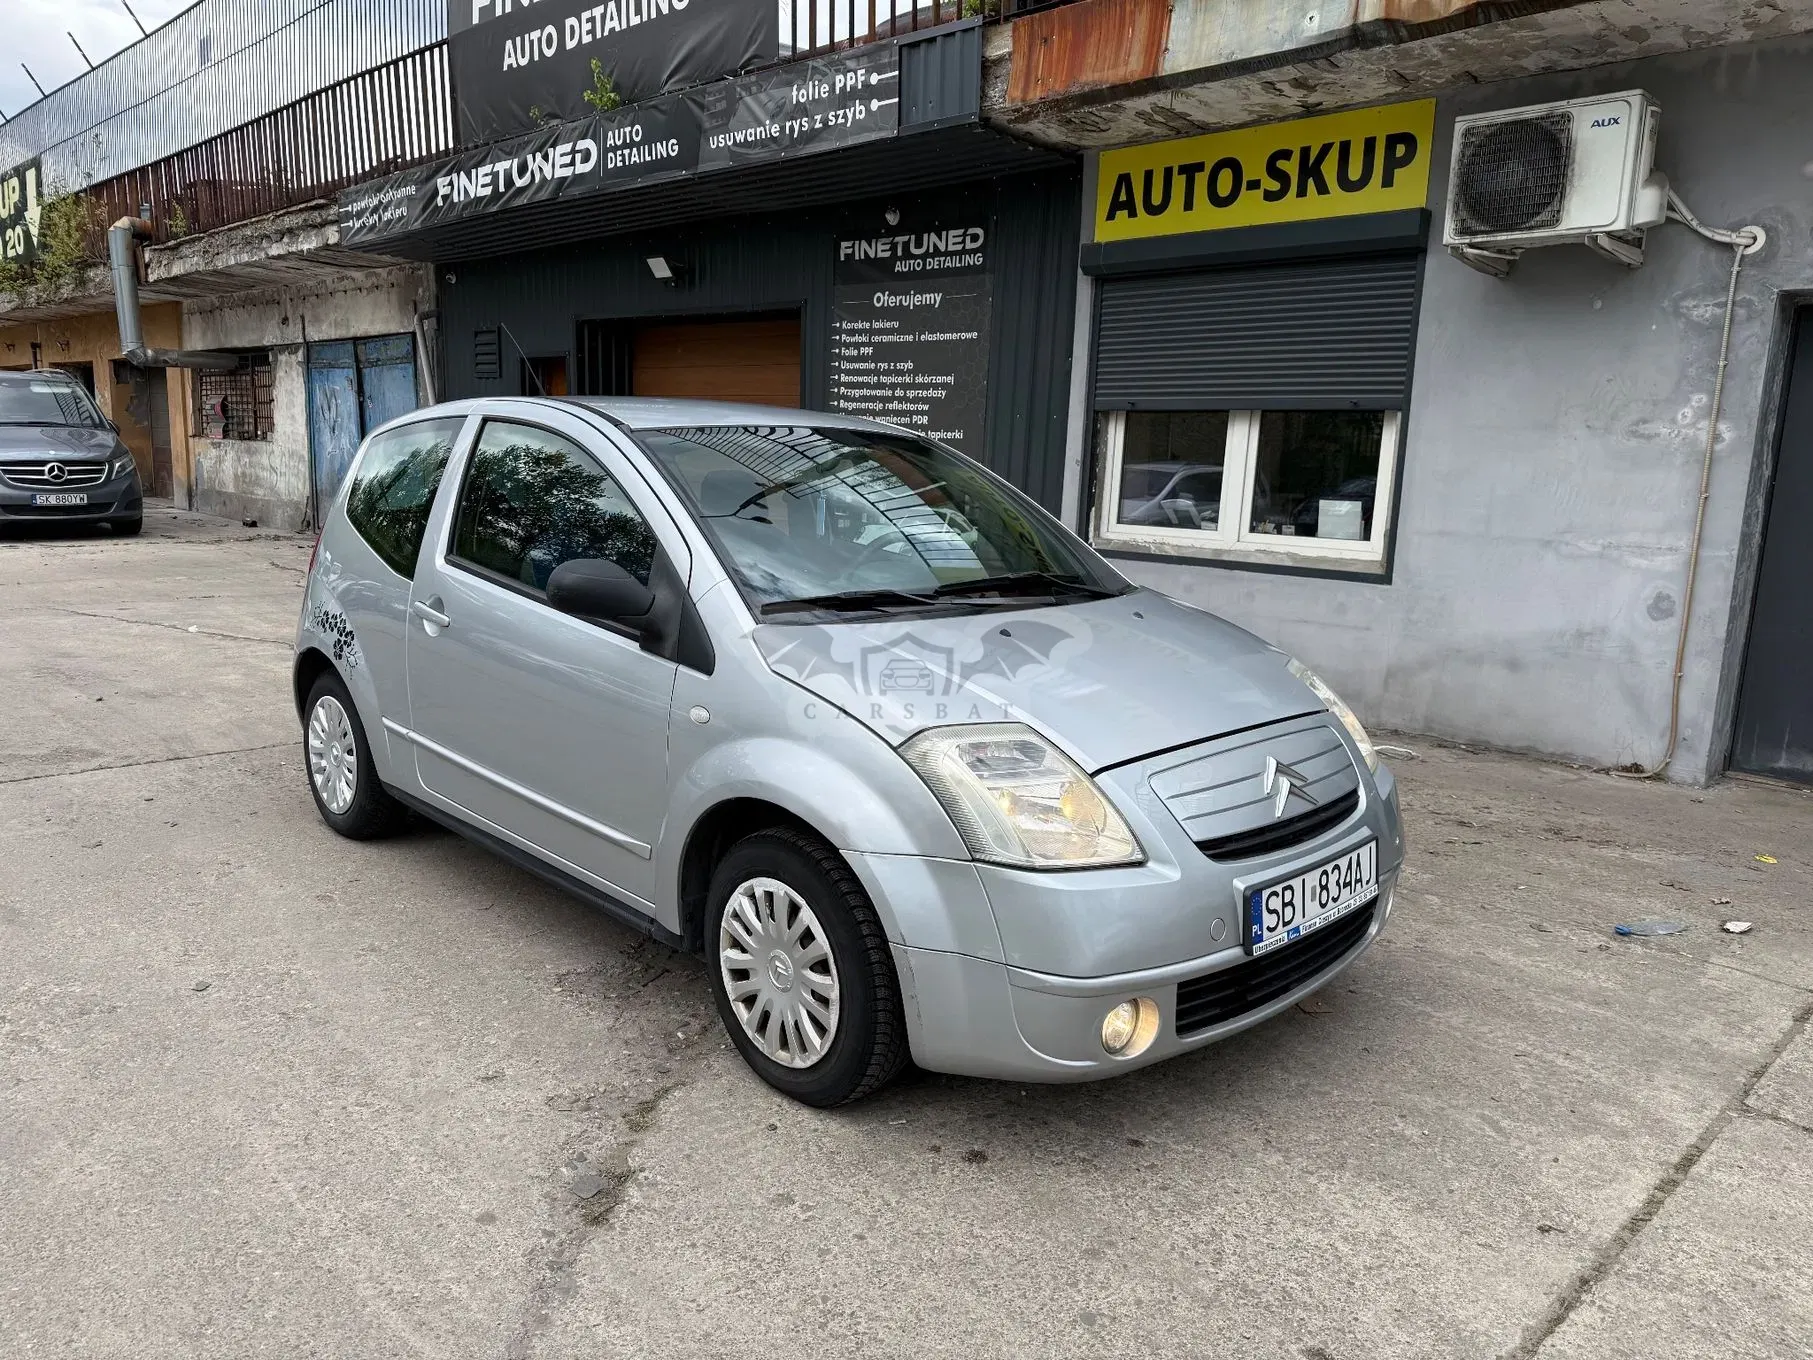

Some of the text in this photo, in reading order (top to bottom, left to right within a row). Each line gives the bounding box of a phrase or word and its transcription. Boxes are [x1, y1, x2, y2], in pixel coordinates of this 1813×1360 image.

[503, 24, 558, 71] AUTO
[791, 69, 866, 104] folie PPF
[709, 100, 866, 148] usuwanie rys z szyb
[1590, 116, 1621, 128] AUX
[606, 124, 643, 148] AUTO
[607, 138, 679, 169] DETAILING
[436, 138, 598, 207] FINETUNED
[1105, 131, 1418, 221] AUTO-SKUP
[839, 227, 985, 261] FINETUNED
[894, 253, 983, 272] AUTO DETAILING
[873, 290, 943, 309] Oferujemy
[872, 319, 899, 329] lakieru
[841, 331, 978, 343] Powłoki ceramiczne i elastomerowe
[841, 346, 874, 356] Folie PPF
[840, 360, 876, 370] Usuwanie
[877, 363, 888, 372] rys
[896, 360, 914, 372] szyb
[880, 373, 914, 385] tapicerki
[915, 374, 955, 385] skórzanej
[839, 387, 947, 399] Przygotowanie do sprzedaży
[885, 400, 930, 411] reflektorów
[912, 415, 928, 424] PDR
[928, 430, 964, 440] tapicerki
[38, 495, 51, 504] SK
[1252, 923, 1262, 937] PL
[1265, 878, 1305, 933] SBI
[1318, 846, 1372, 909] 834AJ
